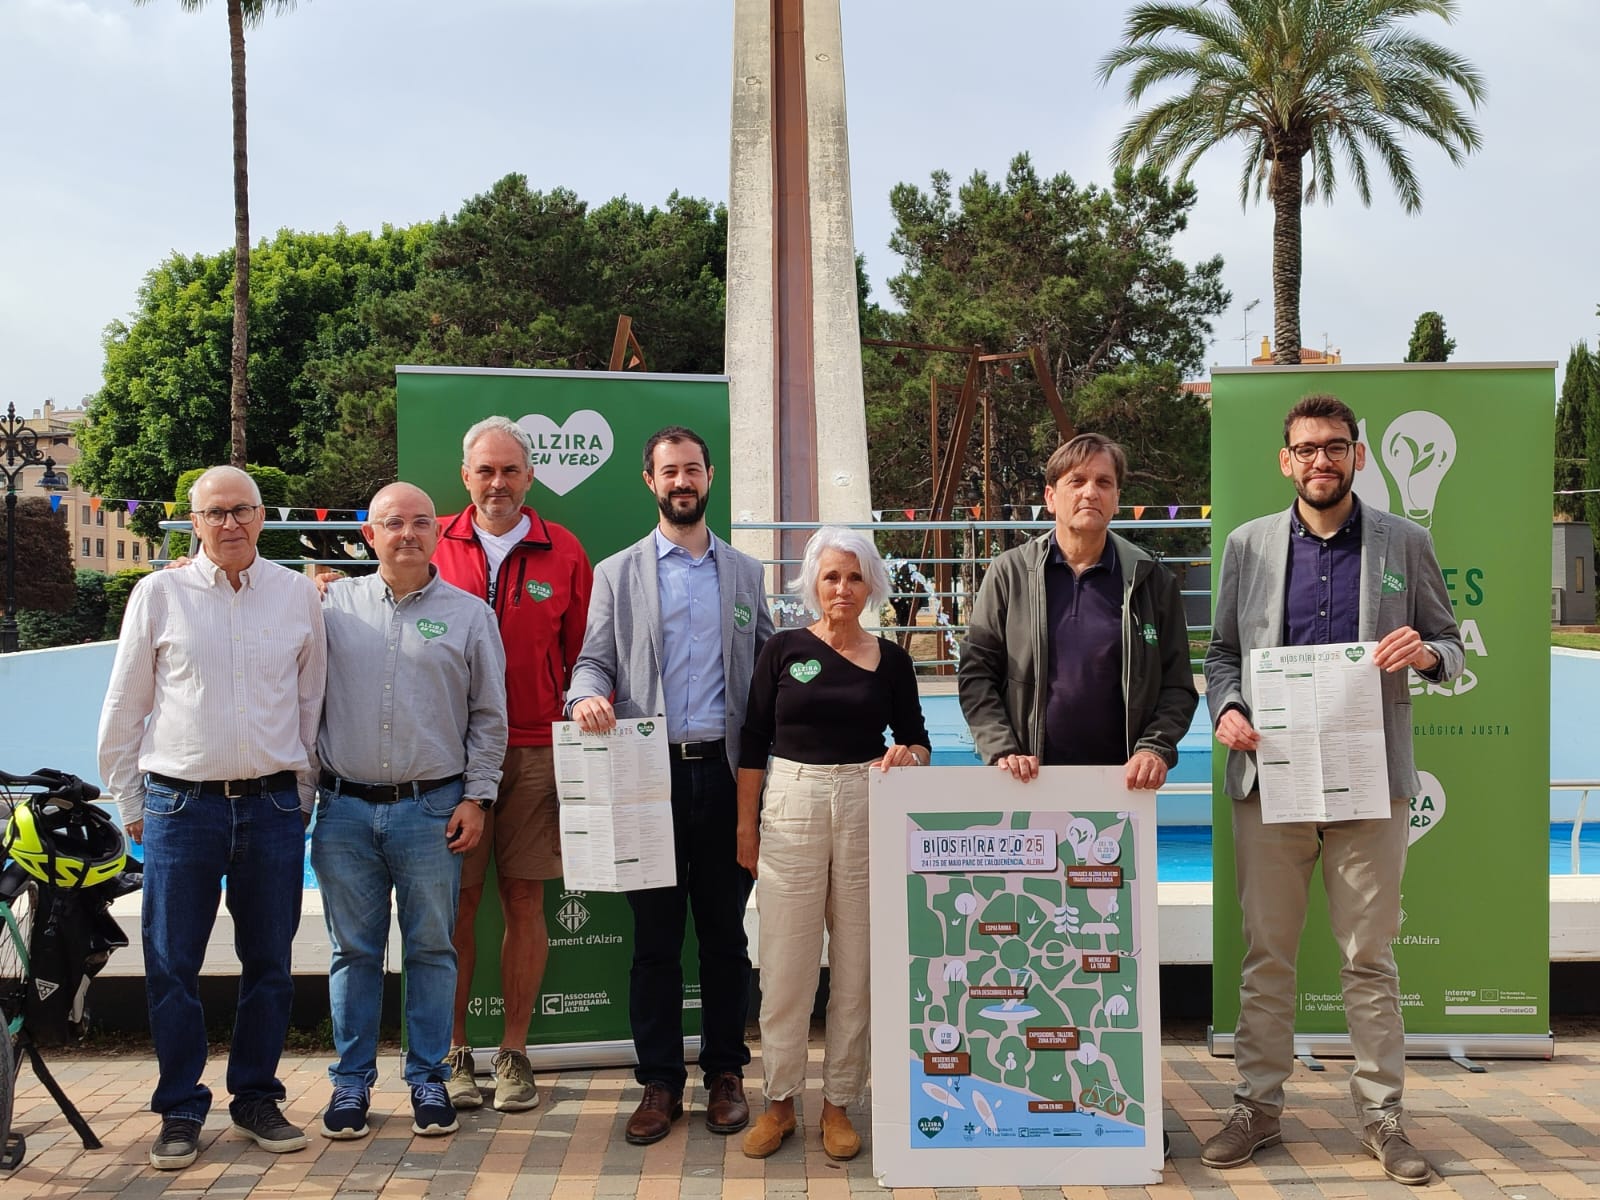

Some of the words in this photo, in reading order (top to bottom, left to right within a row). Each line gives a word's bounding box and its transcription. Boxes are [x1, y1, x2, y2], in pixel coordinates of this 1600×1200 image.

[531, 452, 551, 465] EN
[559, 452, 599, 466] VERD
[1415, 723, 1463, 735] OLÒGICA
[1472, 726, 1509, 735] JUSTA
[923, 838, 995, 854] BIOSFIRA
[548, 937, 584, 947] tament
[586, 933, 623, 945] d'Alzira
[1403, 935, 1440, 945] d'Alzira
[564, 991, 607, 1000] ASSOCIACIÓ
[1305, 992, 1343, 1004] Diputació
[1445, 989, 1476, 997] Interreg
[564, 998, 611, 1007] EMPRESARIAL
[1317, 1003, 1345, 1012] Valènci
